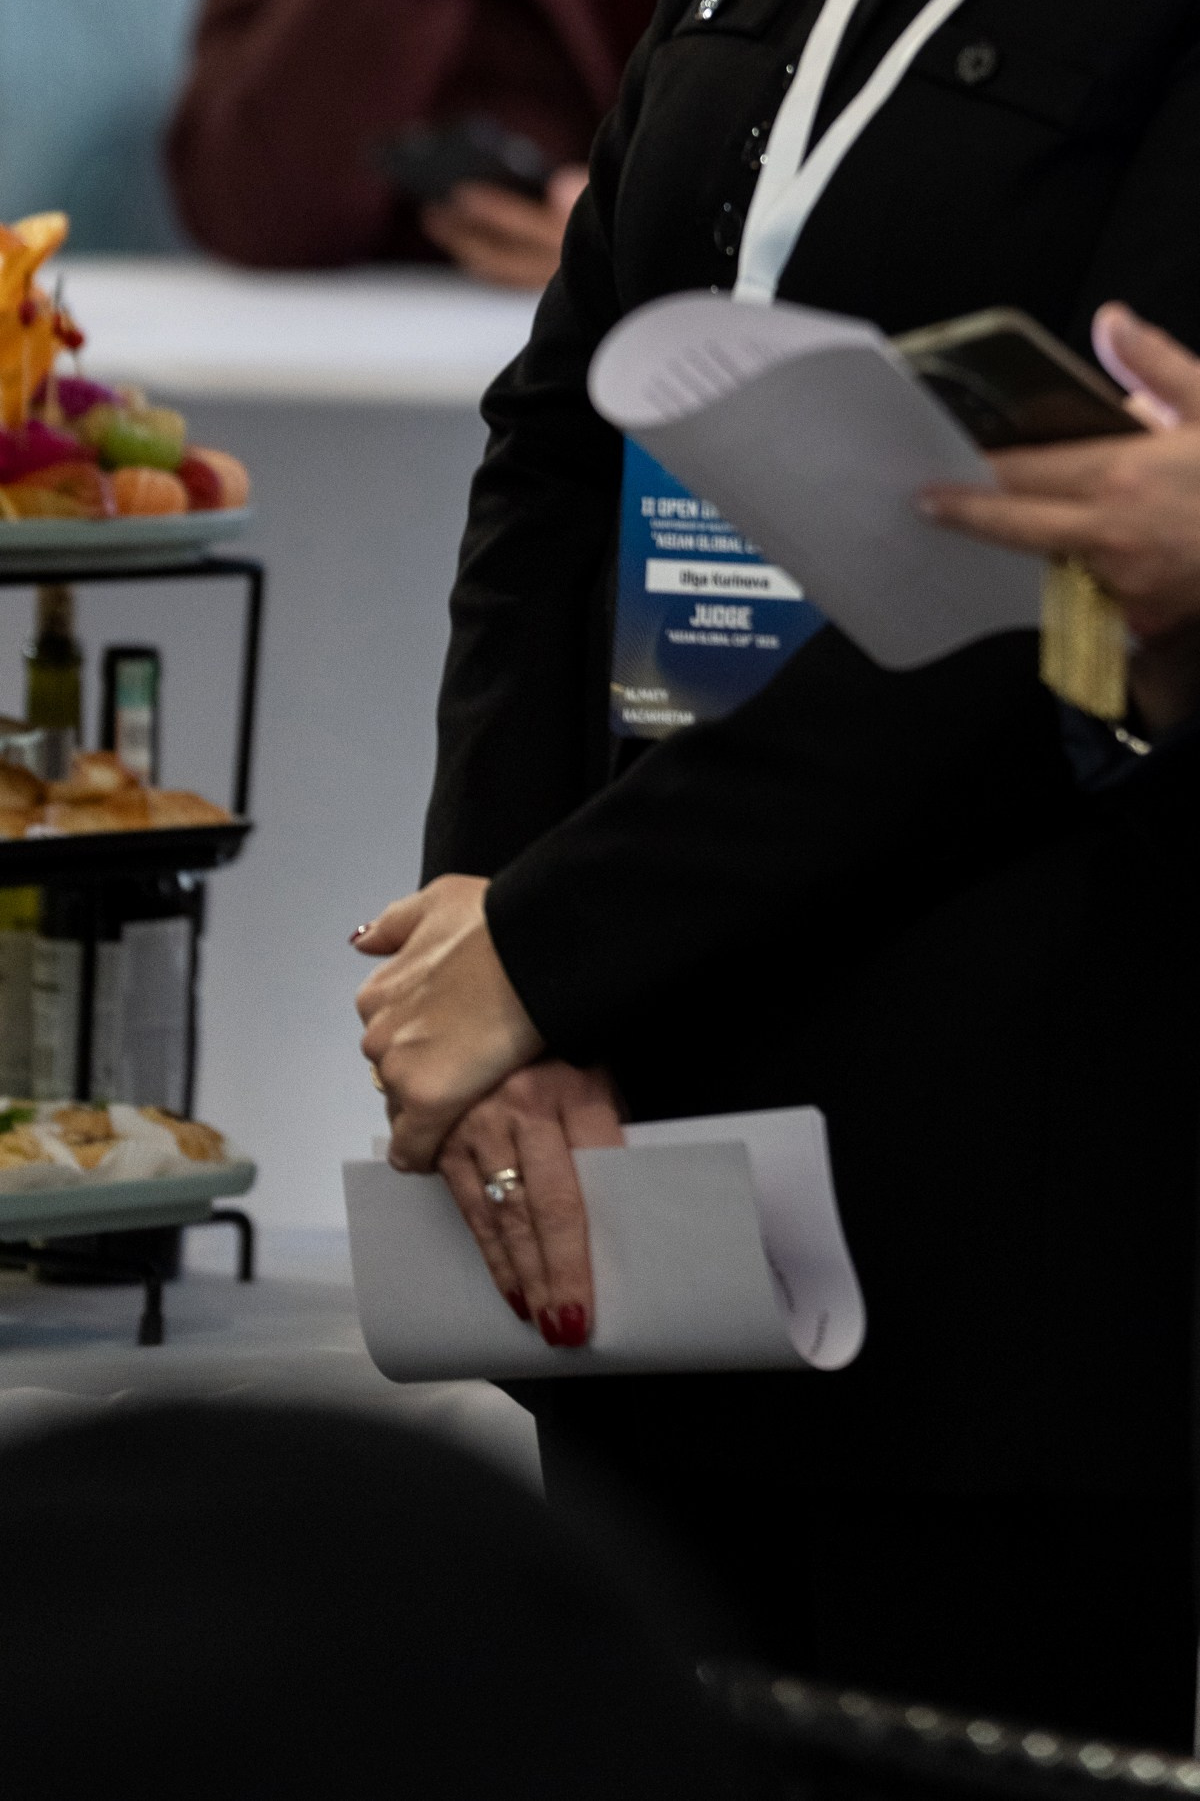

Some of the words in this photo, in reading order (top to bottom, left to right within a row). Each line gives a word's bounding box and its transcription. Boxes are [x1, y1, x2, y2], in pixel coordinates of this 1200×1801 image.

[657, 497, 699, 519] OPEN
[696, 535, 743, 555] GLOBAL
[681, 569, 707, 588] Olga
[690, 604, 753, 630] JUDGE
